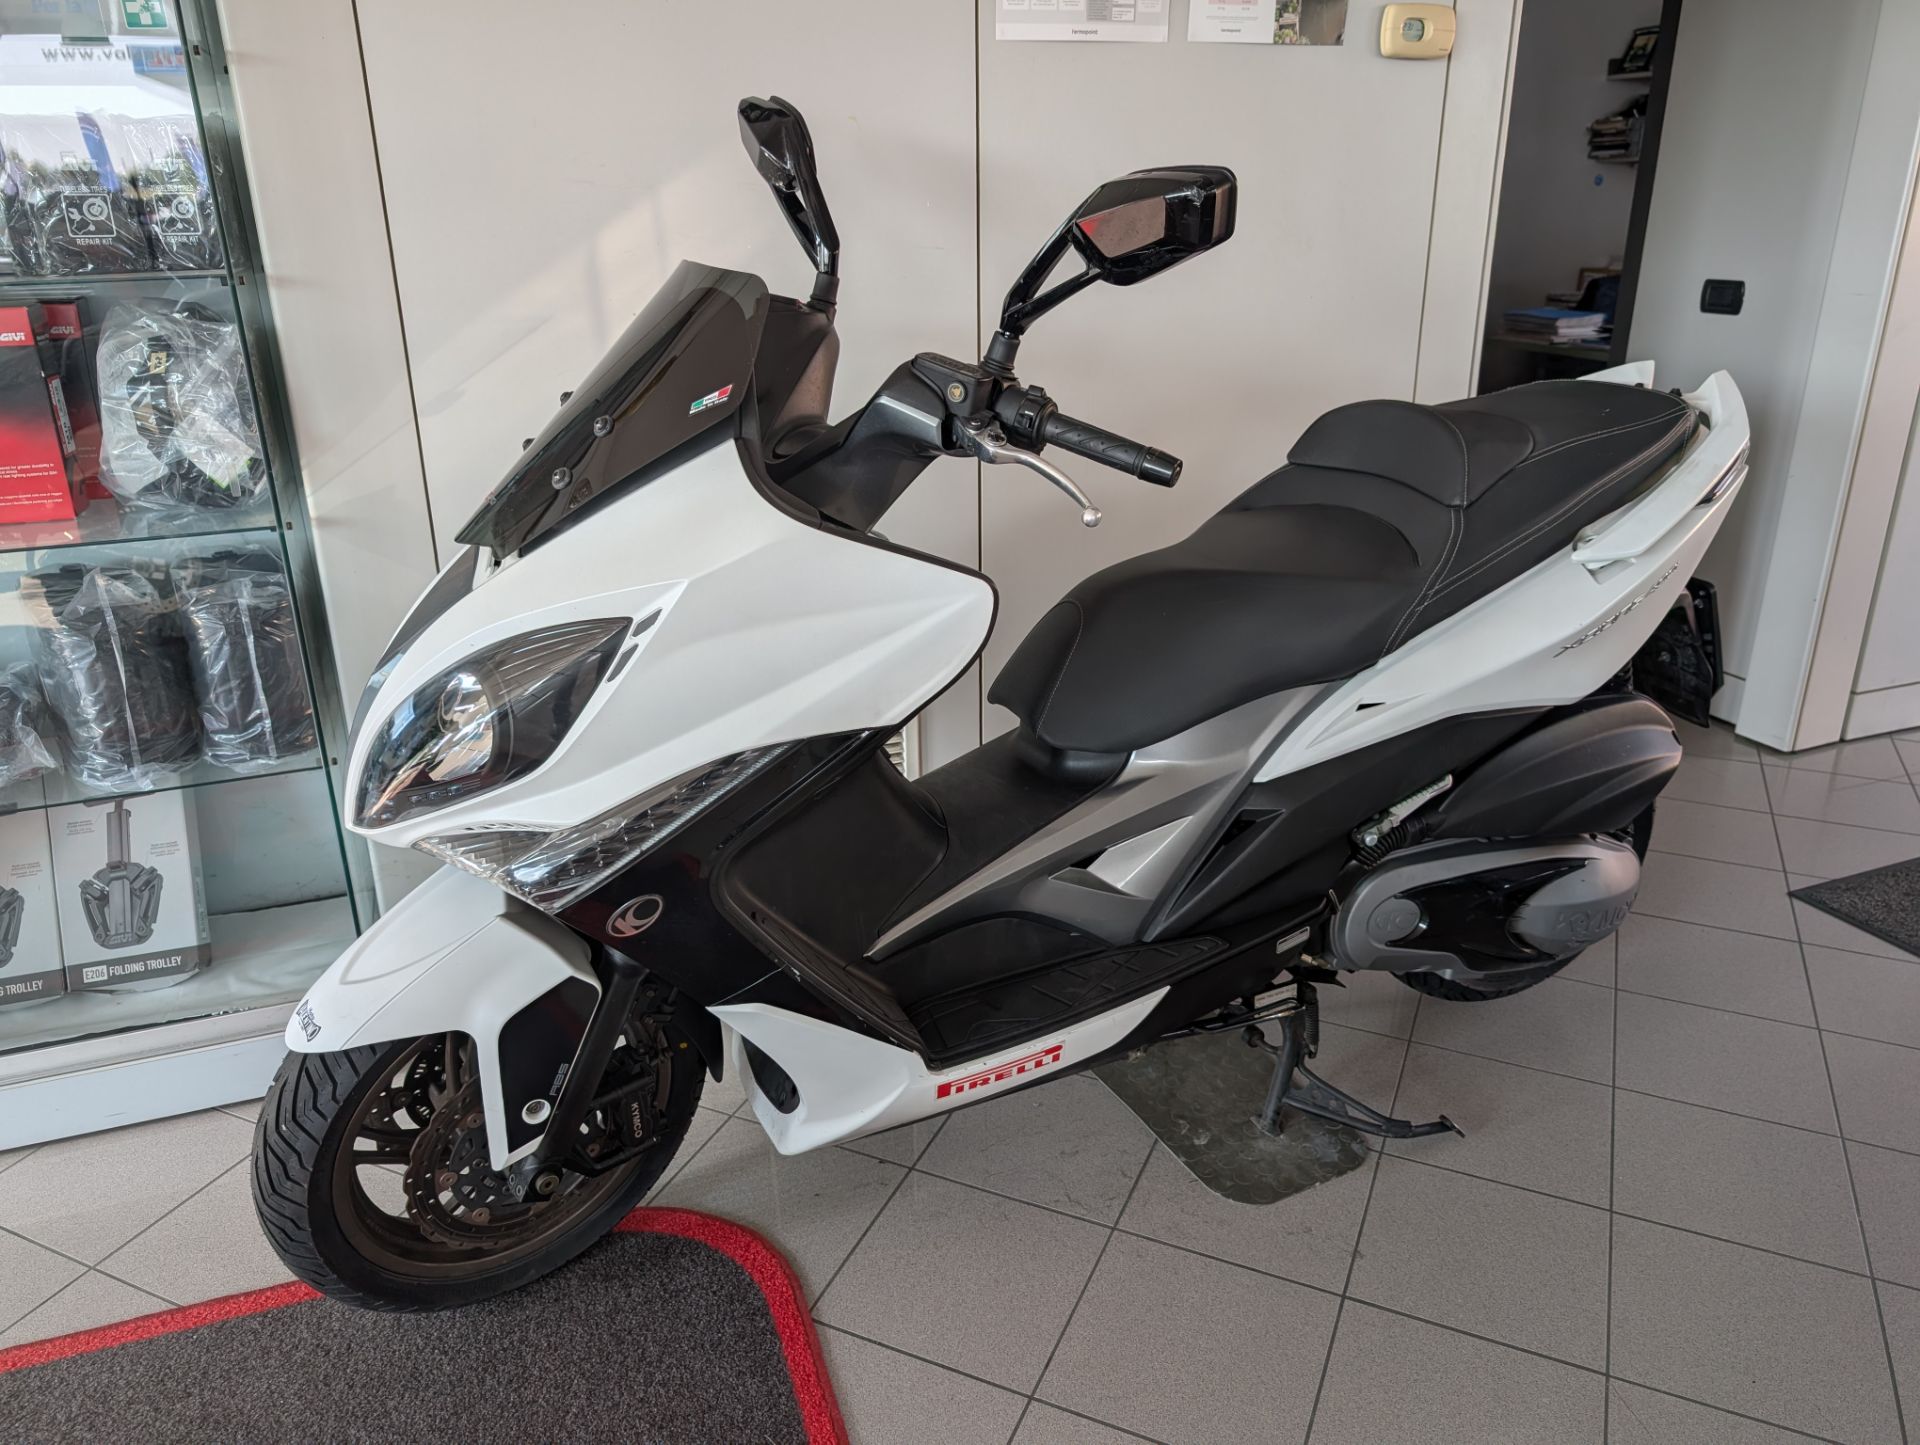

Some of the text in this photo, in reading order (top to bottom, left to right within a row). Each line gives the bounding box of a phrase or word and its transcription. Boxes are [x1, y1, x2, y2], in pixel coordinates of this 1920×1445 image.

[76, 238, 100, 246] REPAIR
[0, 332, 25, 341] GIVI
[50, 326, 75, 334] GIVI
[84, 956, 182, 981] E206 FOLDING TROLLEY
[6, 979, 43, 995] TROLLEY
[549, 1063, 569, 1096] ABS
[936, 1044, 1064, 1099] PIRELLI
[631, 1102, 643, 1138] KYMCO
